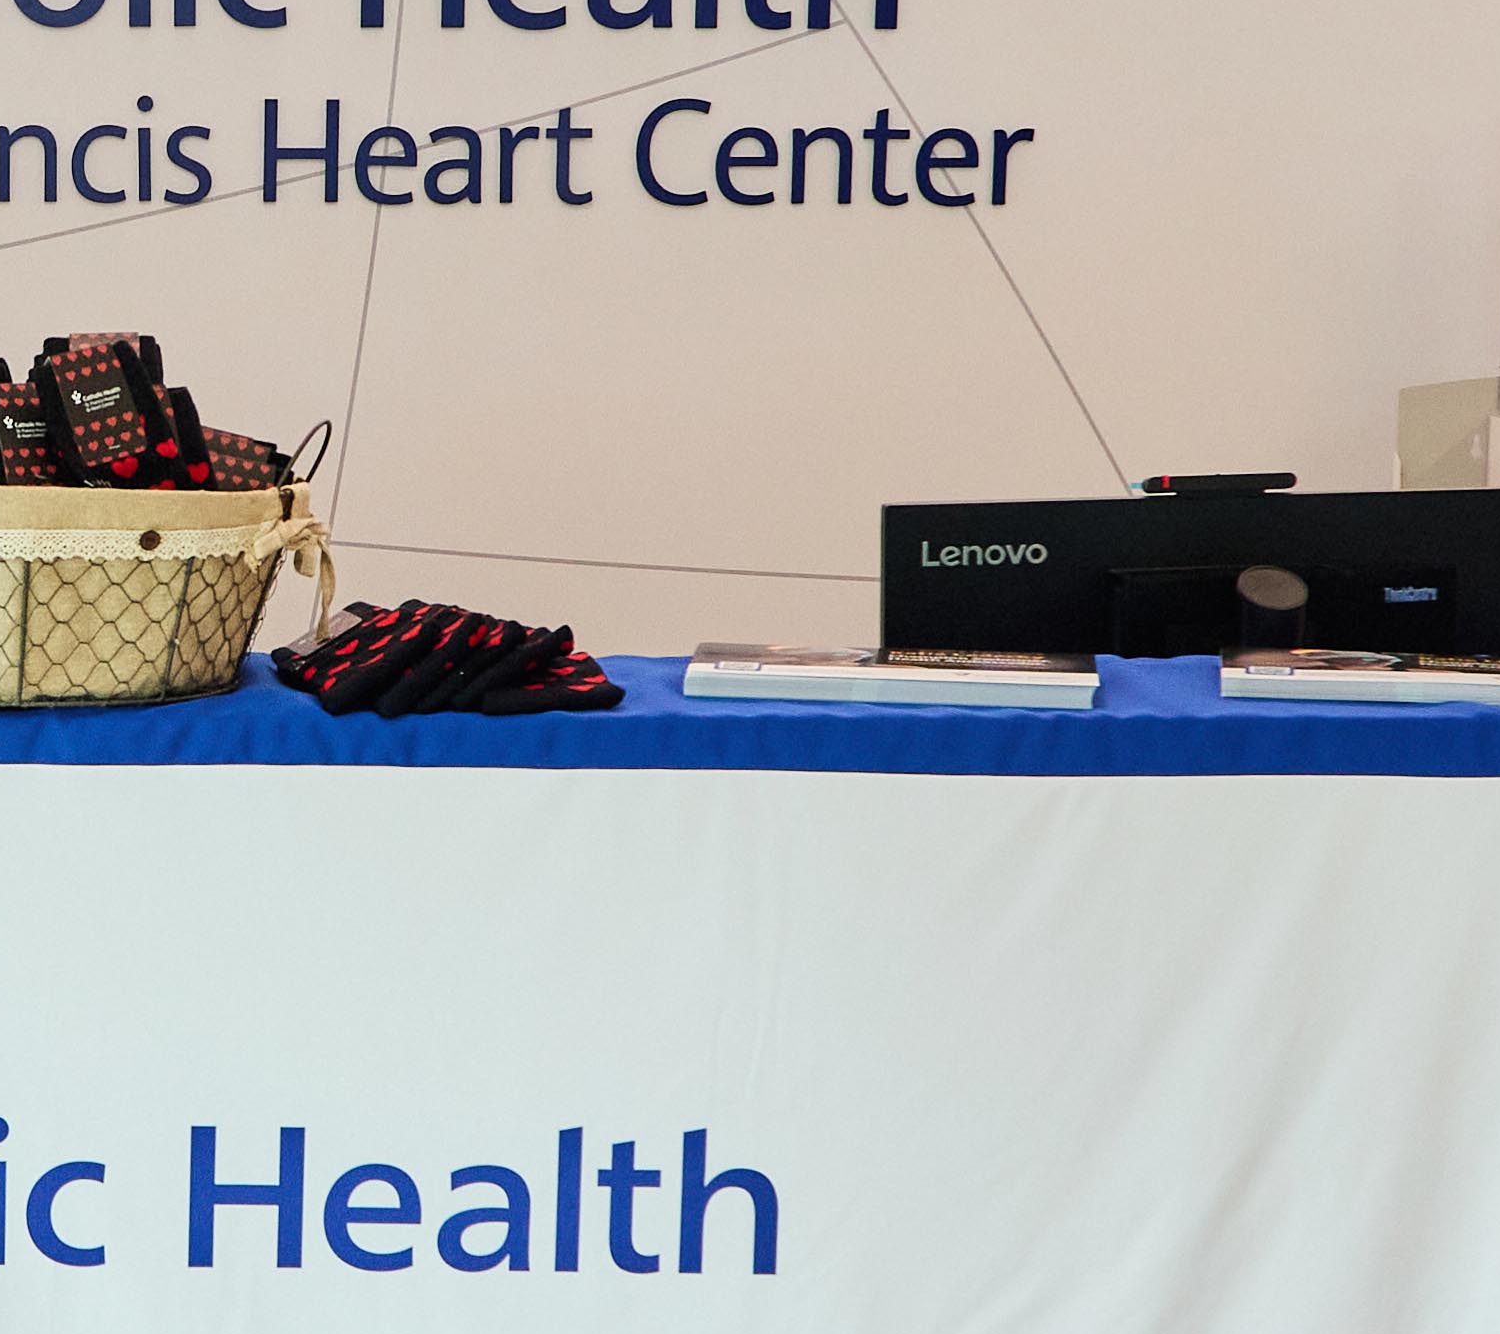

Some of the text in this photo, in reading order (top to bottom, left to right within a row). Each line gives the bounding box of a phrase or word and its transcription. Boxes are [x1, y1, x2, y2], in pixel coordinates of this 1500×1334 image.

[263, 99, 594, 207] Heart
[636, 99, 1036, 209] Center
[921, 540, 1048, 567] Lenovo
[188, 1126, 780, 1276] Health
